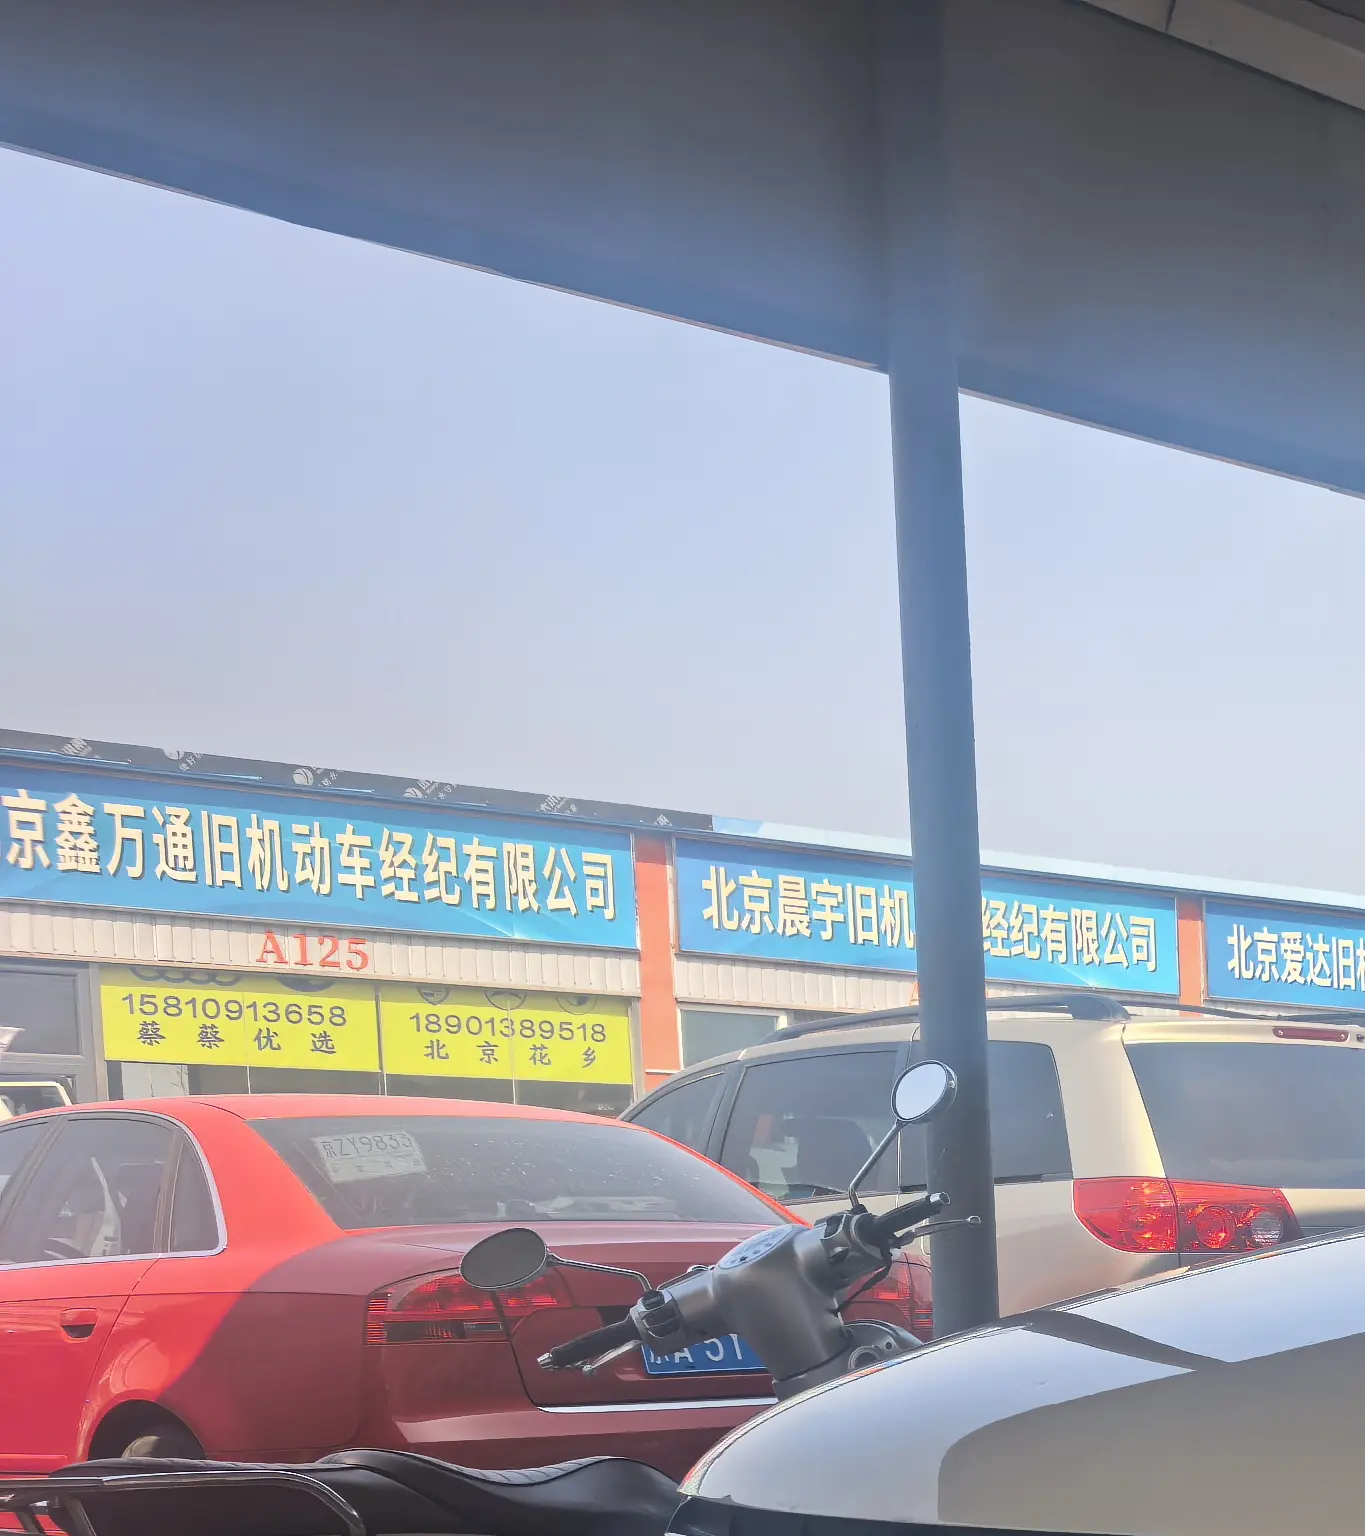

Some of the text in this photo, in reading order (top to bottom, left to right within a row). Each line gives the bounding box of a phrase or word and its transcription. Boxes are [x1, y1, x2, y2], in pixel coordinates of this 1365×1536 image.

[0, 788, 616, 921] 京鑫万通旧机动车经纪有限公司
[256, 928, 369, 971] A125
[121, 993, 347, 1027] 15810913658
[409, 1012, 607, 1043] 18901389518
[424, 1038, 597, 1068] 北京花乡
